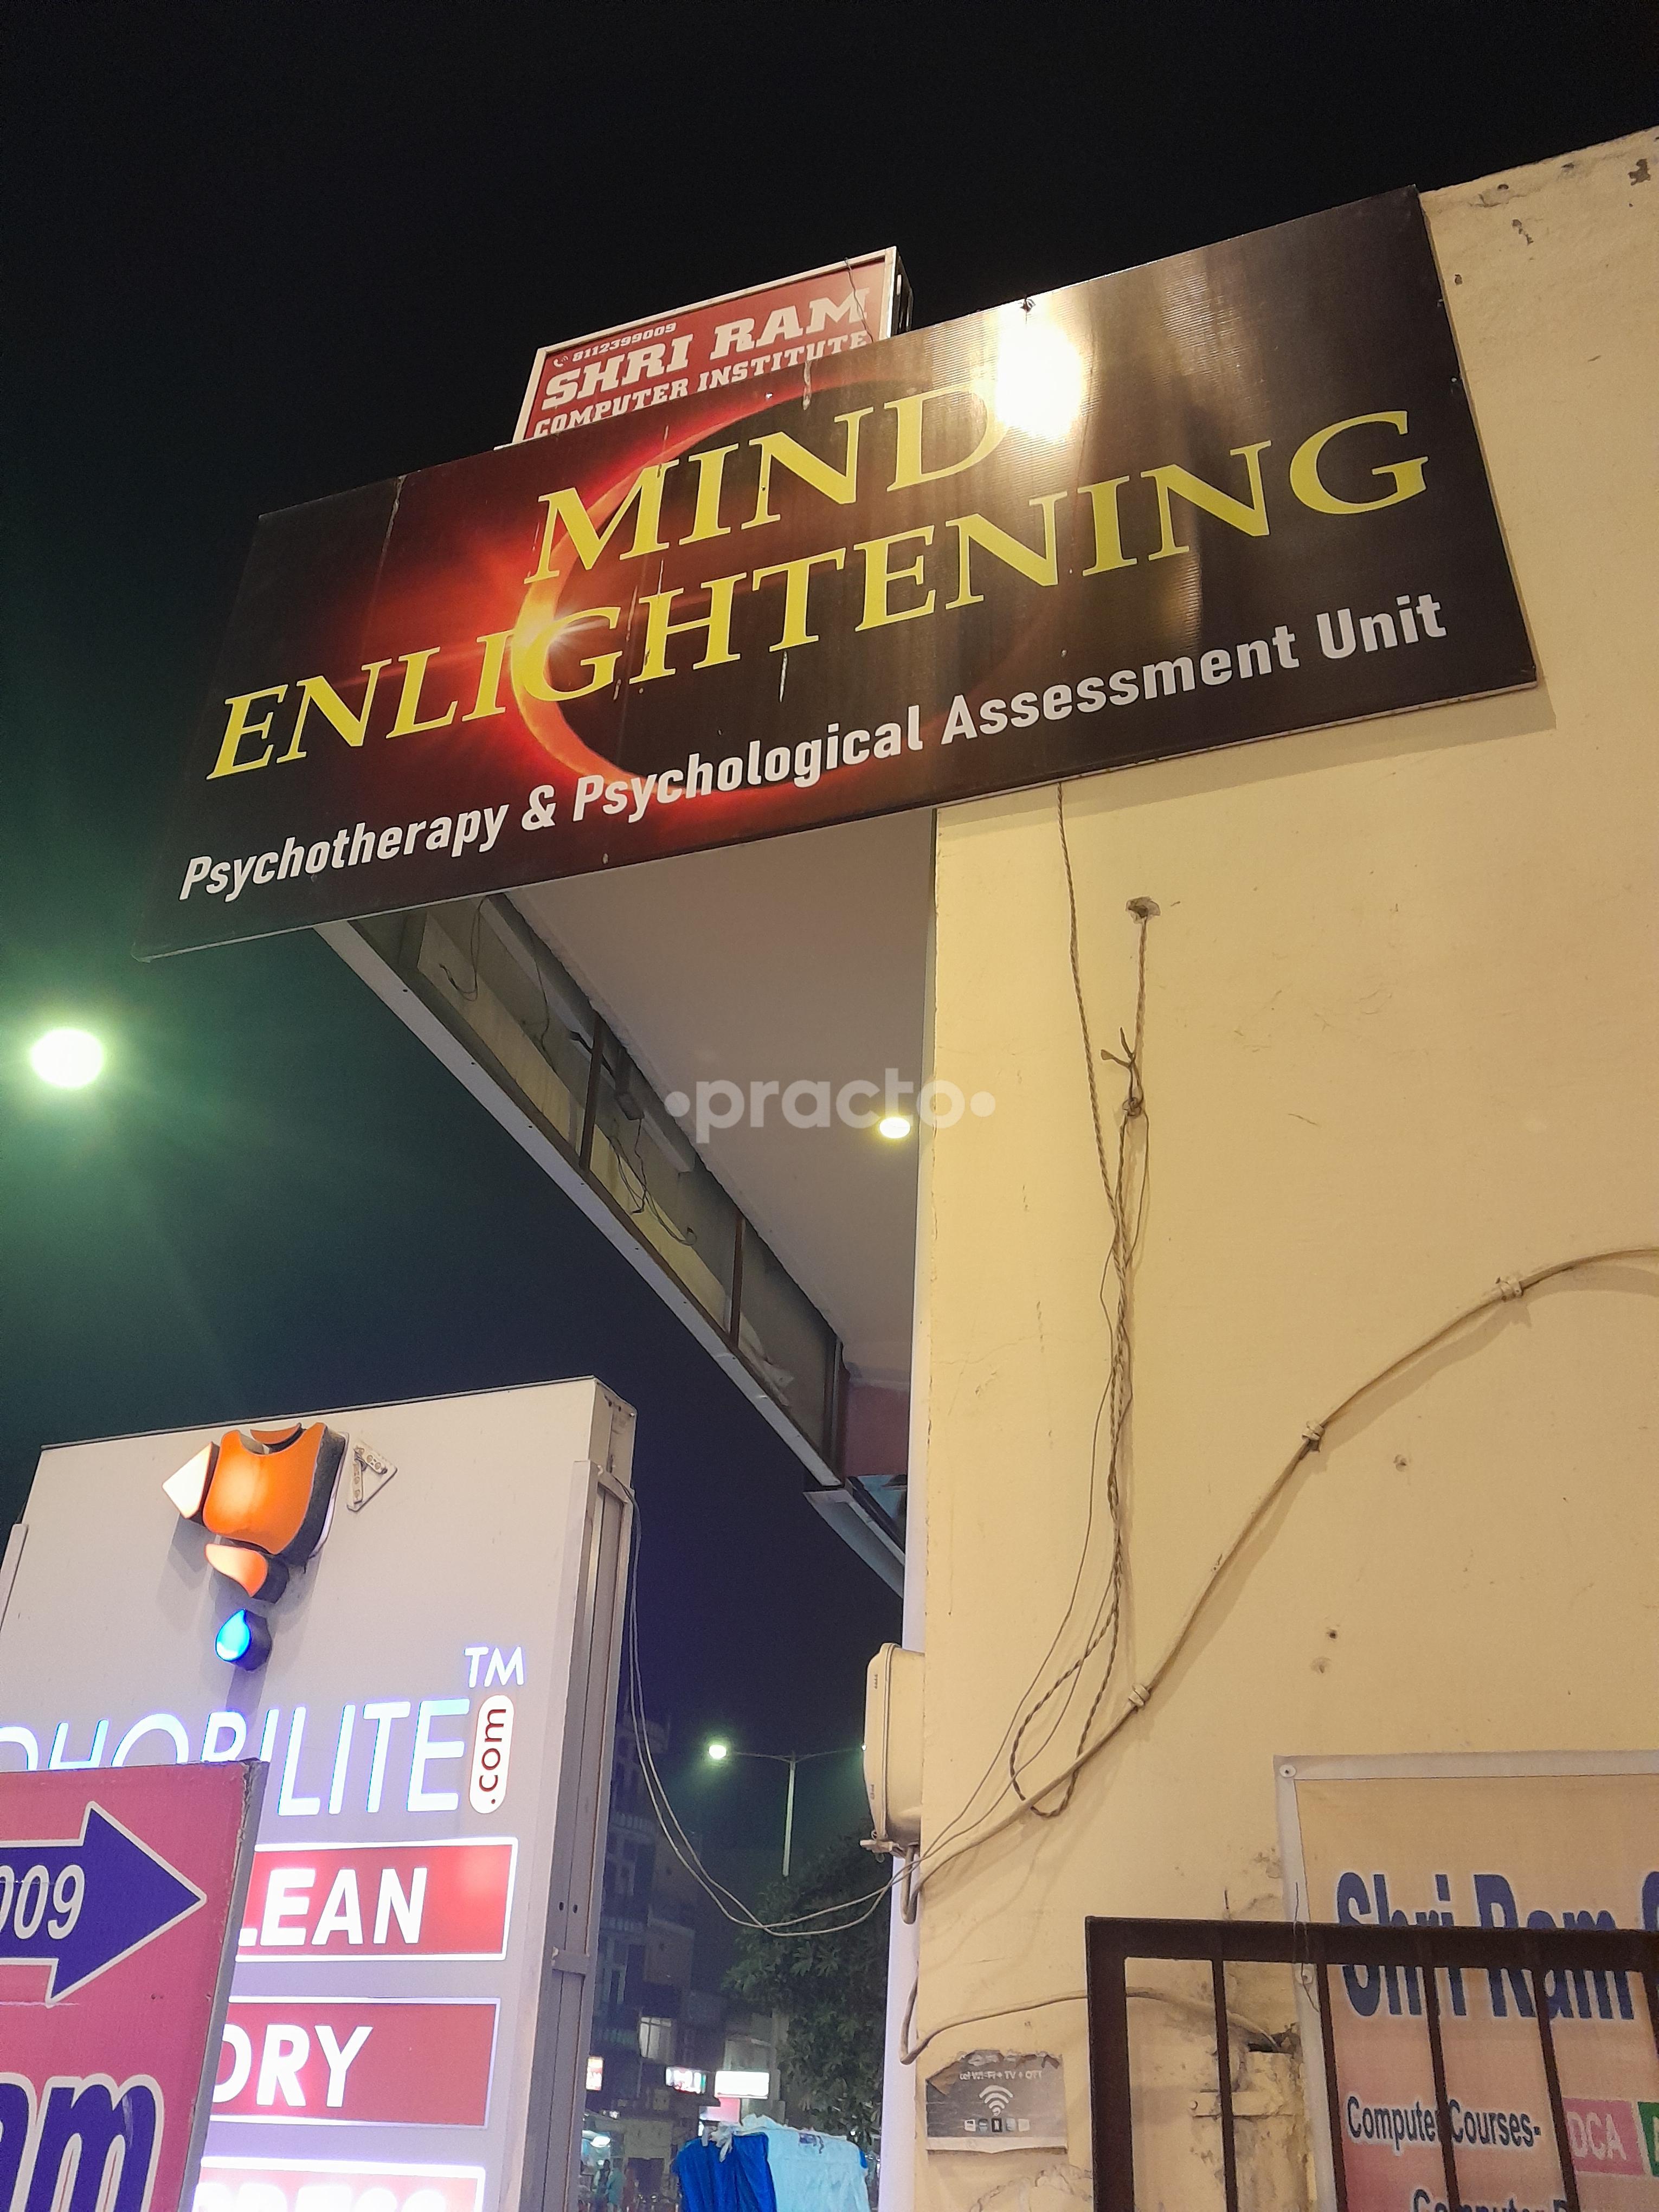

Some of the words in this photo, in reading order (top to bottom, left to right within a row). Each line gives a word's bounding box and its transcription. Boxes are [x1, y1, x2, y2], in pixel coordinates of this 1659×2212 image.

[533, 378, 689, 438] COMPUTER
[697, 330, 867, 393] INSTITUTE
[542, 333, 693, 410] SHRI
[710, 287, 870, 360] RAM
[573, 323, 677, 362] 8112399009
[524, 381, 1009, 584] MIND
[207, 410, 1429, 780] ENLIGHTENING
[178, 801, 510, 901] Psychotherapy
[521, 784, 556, 831] &
[573, 704, 923, 822] Psychological
[940, 625, 1300, 745] Assessment
[1315, 593, 1448, 660] Unit
[478, 1707, 507, 1805] .com
[238, 1867, 428, 1947] EAN
[1347, 2095, 1439, 2152] Compute
